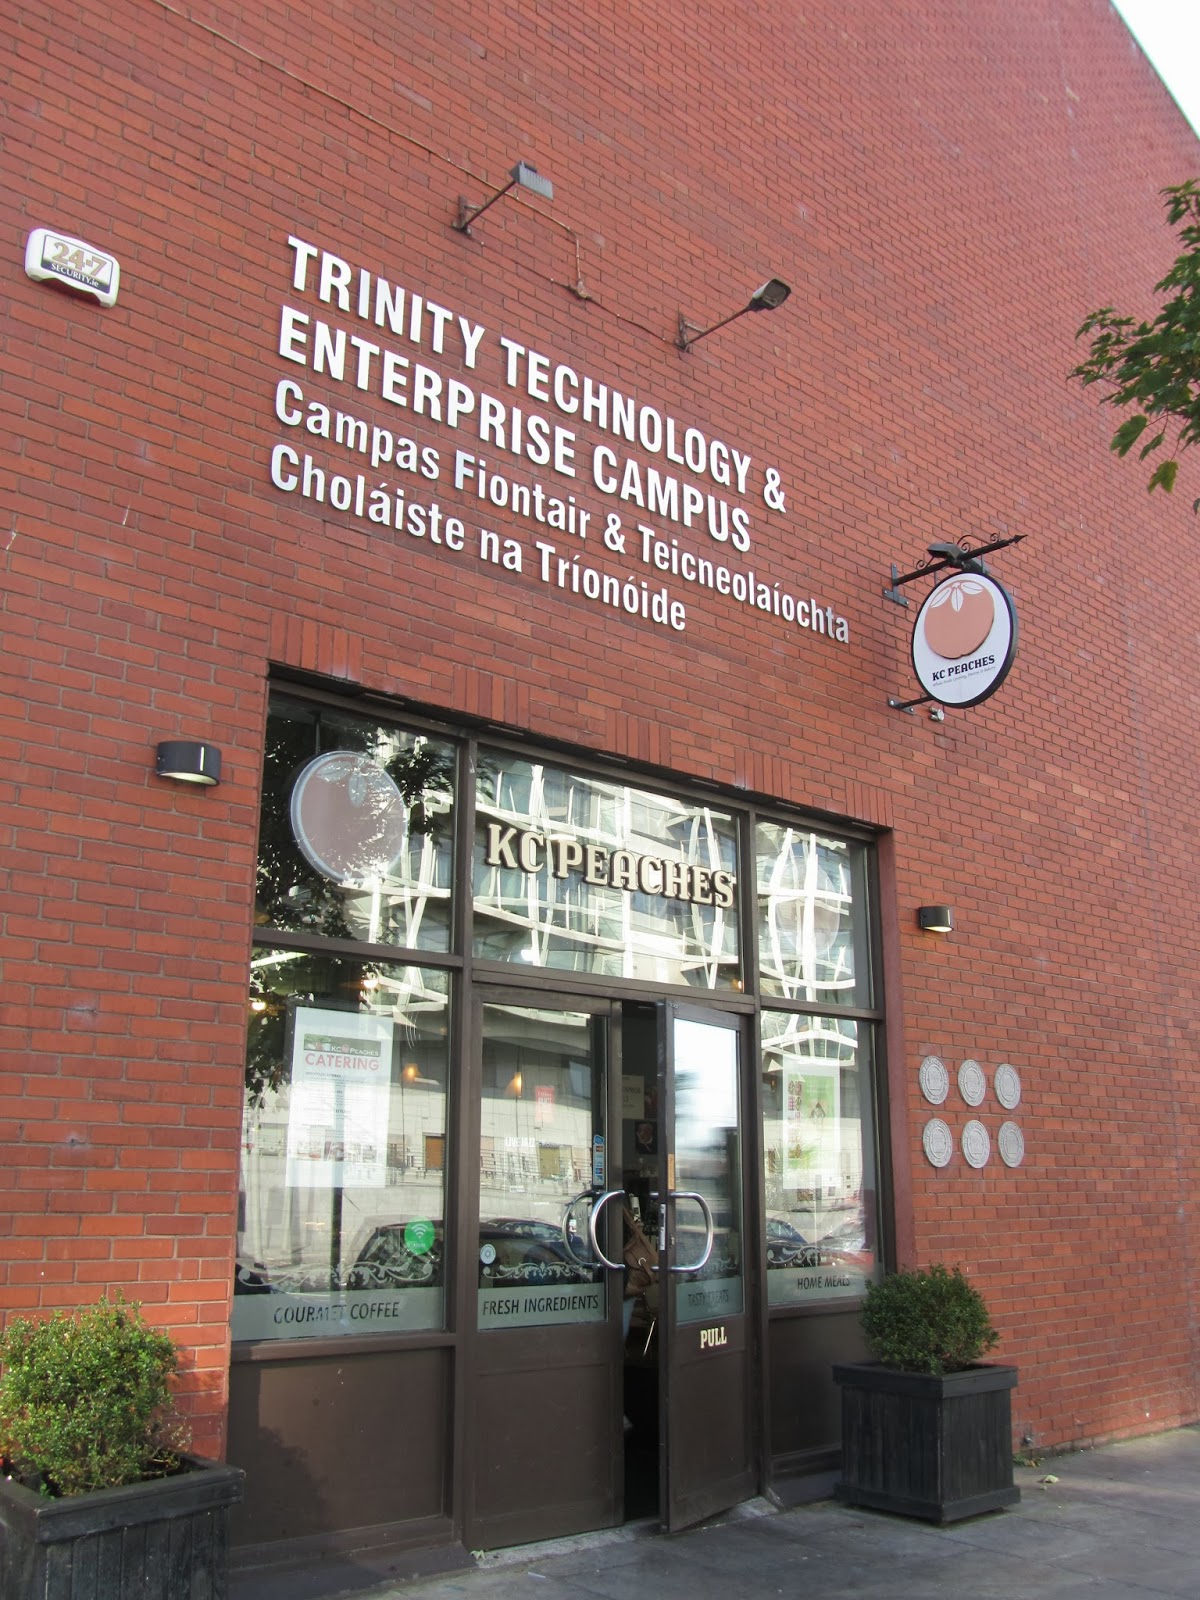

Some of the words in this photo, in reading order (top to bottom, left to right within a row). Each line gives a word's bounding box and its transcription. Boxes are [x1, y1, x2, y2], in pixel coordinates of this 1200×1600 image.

[287, 234, 486, 369] TRINITY
[500, 336, 752, 495] TECHNOLOGY
[763, 467, 787, 514] &
[279, 304, 577, 478] ENTERPRISE
[593, 444, 752, 553] CAMPUS
[275, 379, 441, 480] Campas
[454, 449, 591, 539] Fiontair
[603, 512, 627, 554] &
[637, 523, 850, 645] Teicneolaíochta
[271, 443, 465, 551] Choláiste
[480, 528, 523, 573] na
[535, 540, 687, 631] Tríonóide
[932, 669, 946, 681] KC
[948, 654, 995, 677] PEACHES
[485, 823, 545, 875] KC
[555, 838, 735, 909] PEACHES
[305, 1053, 380, 1071] CATERING
[350, 1047, 379, 1057] PEACHES
[797, 1276, 822, 1290] HOME
[824, 1275, 851, 1288] MEALS
[350, 1302, 400, 1320] COFFEE
[482, 1299, 520, 1316] FRESH
[524, 1294, 599, 1313] INGREDIENTS
[700, 1326, 728, 1349] PULL
